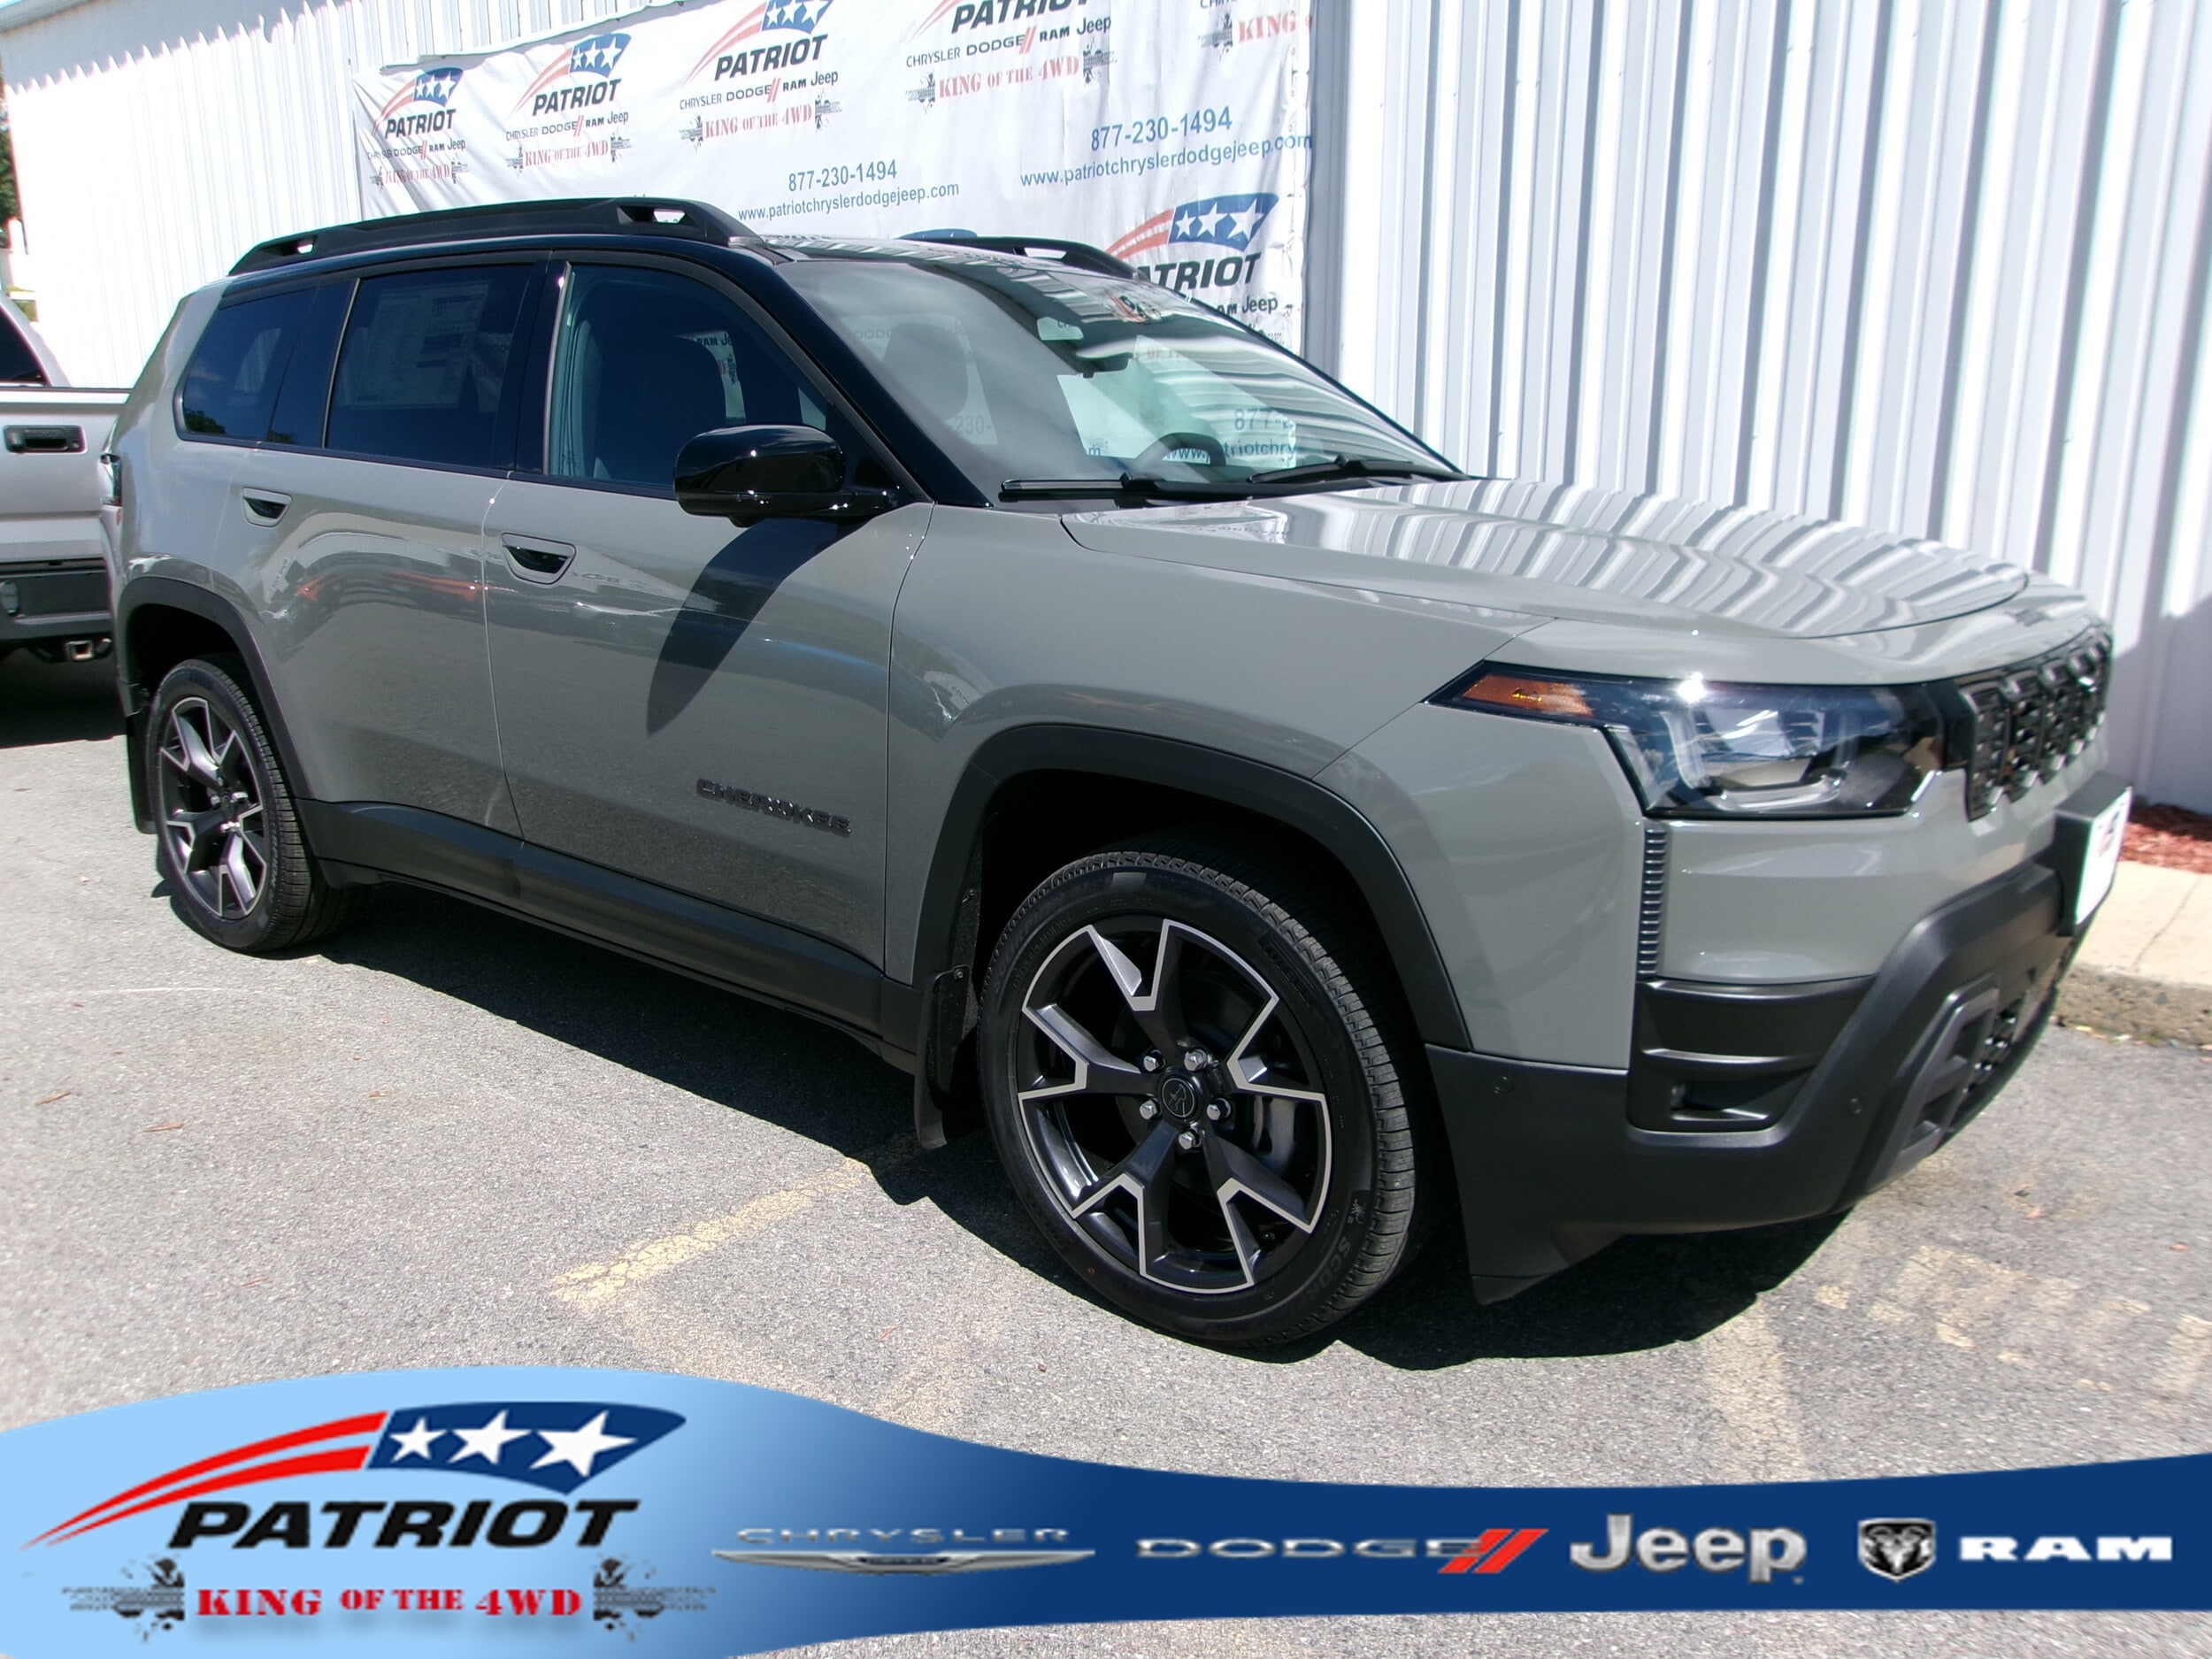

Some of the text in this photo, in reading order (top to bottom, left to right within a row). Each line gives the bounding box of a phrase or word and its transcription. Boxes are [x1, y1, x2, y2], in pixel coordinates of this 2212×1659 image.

[951, 0, 1089, 34] PATRI
[714, 34, 828, 81] PATRIOT
[906, 16, 1111, 68] CHRYSLER DODGE RAM Jeep
[680, 71, 838, 111] CHRYSLER DODGE RAM Jeep
[939, 55, 1079, 98] KING OF THE 4WD
[532, 78, 622, 117] PATRIOT
[384, 109, 457, 140] PATRIOT
[505, 111, 629, 142] CHRYSLER DODGE RAM Jeep
[705, 117, 738, 138] KING
[758, 112, 778, 128] THE
[782, 104, 812, 126] 4WD
[1091, 106, 1233, 151] 877-230-1494
[429, 142, 444, 153] RAM
[447, 137, 466, 152] Jeep
[525, 148, 550, 166] KING
[1020, 134, 1312, 186] www.patriotchryslerdodgejeep.com
[789, 158, 897, 192] 877-230-1494
[738, 182, 959, 221] www.patriotchryslerdodgejeep.com
[1137, 252, 1262, 293] TRIOT
[1241, 296, 1279, 314] Jeep
[696, 779, 851, 838] CHEROKEE
